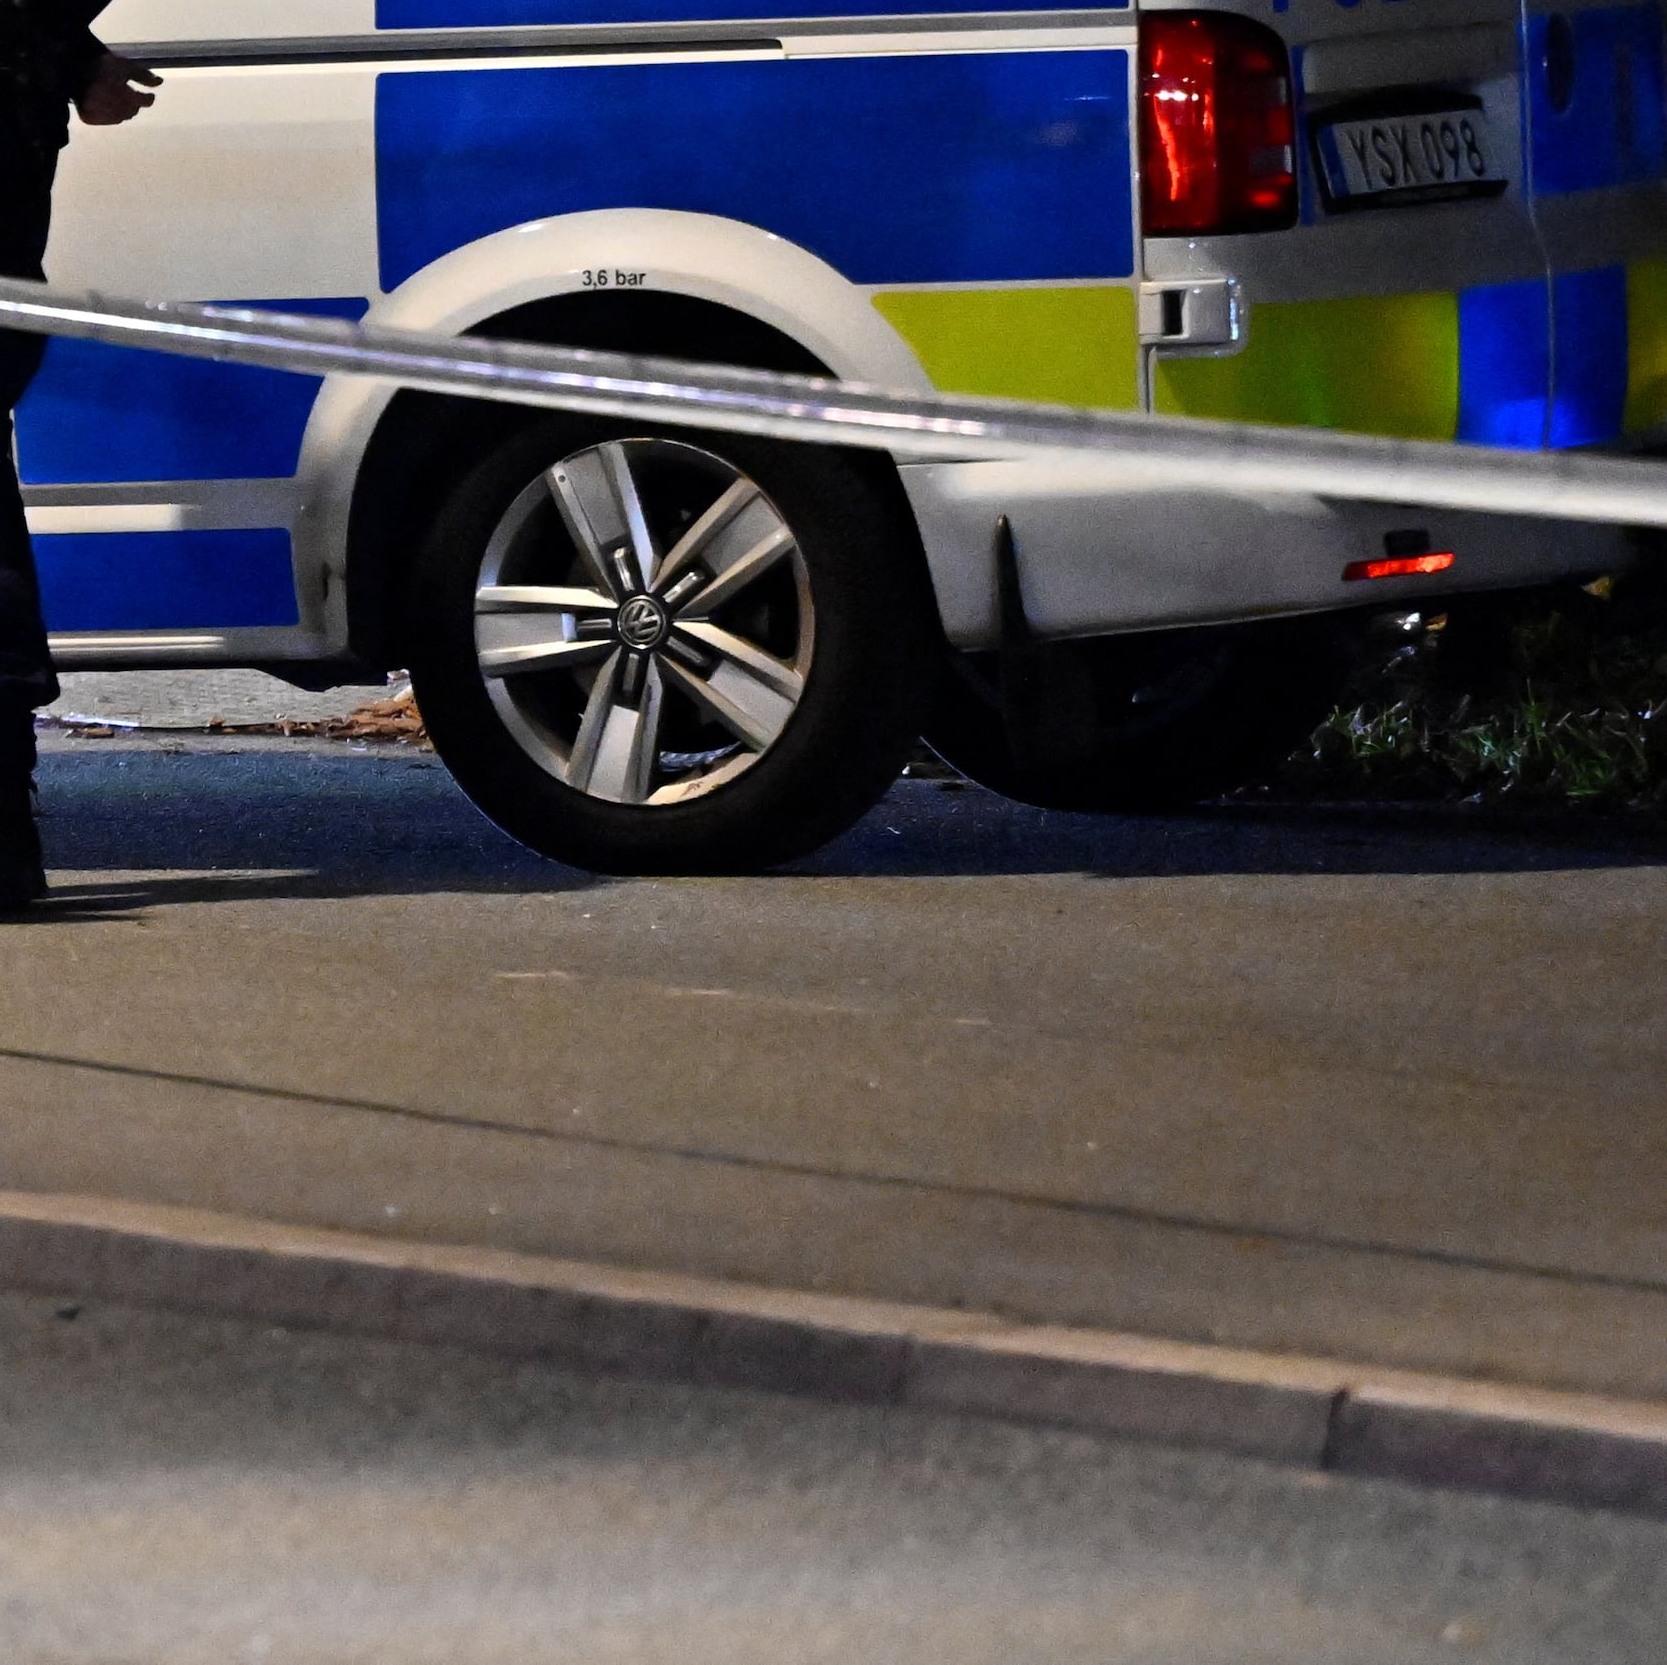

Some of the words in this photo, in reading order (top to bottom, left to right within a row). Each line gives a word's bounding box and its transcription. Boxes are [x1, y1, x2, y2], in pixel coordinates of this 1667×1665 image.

[1343, 122, 1418, 190] YSX
[1420, 119, 1485, 178] 098
[581, 269, 609, 290] 3,6
[614, 269, 647, 286] bar
